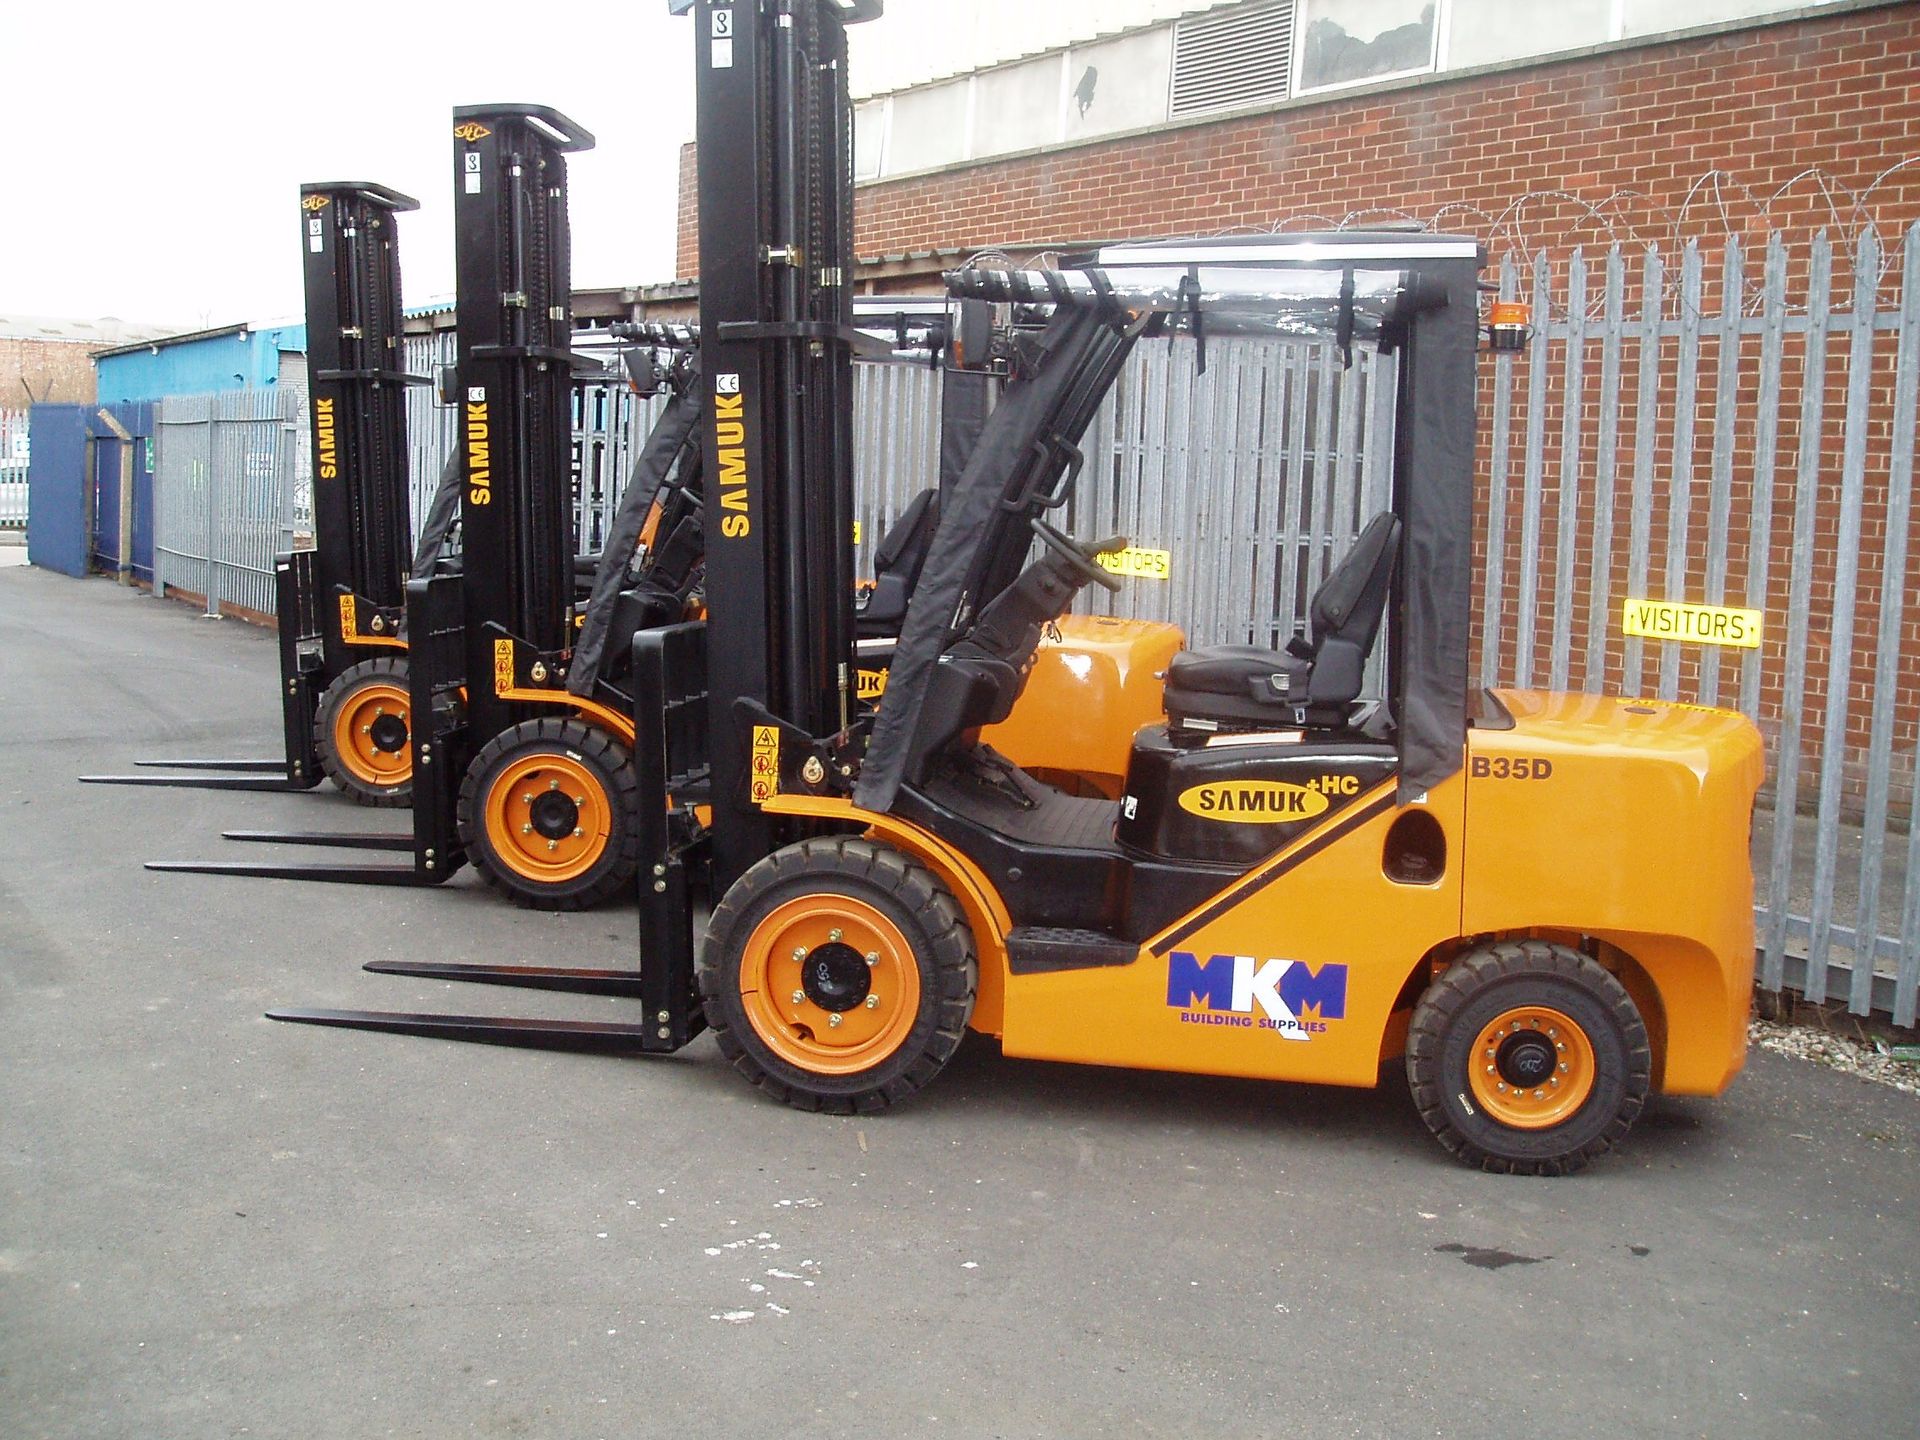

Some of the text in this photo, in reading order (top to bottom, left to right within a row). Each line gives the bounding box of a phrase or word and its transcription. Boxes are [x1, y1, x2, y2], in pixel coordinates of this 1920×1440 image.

[718, 376, 737, 391] CE
[317, 398, 337, 480] SAMUK
[467, 402, 491, 506] SAMUK
[715, 393, 750, 538] SAMUK
[1639, 606, 1744, 640] VISITORS
[1471, 756, 1553, 780] B35D
[1199, 789, 1306, 812] SAMUK
[1166, 951, 1348, 1041] MKM
[1181, 1012, 1327, 1033] BUILDING SUPPLIES
